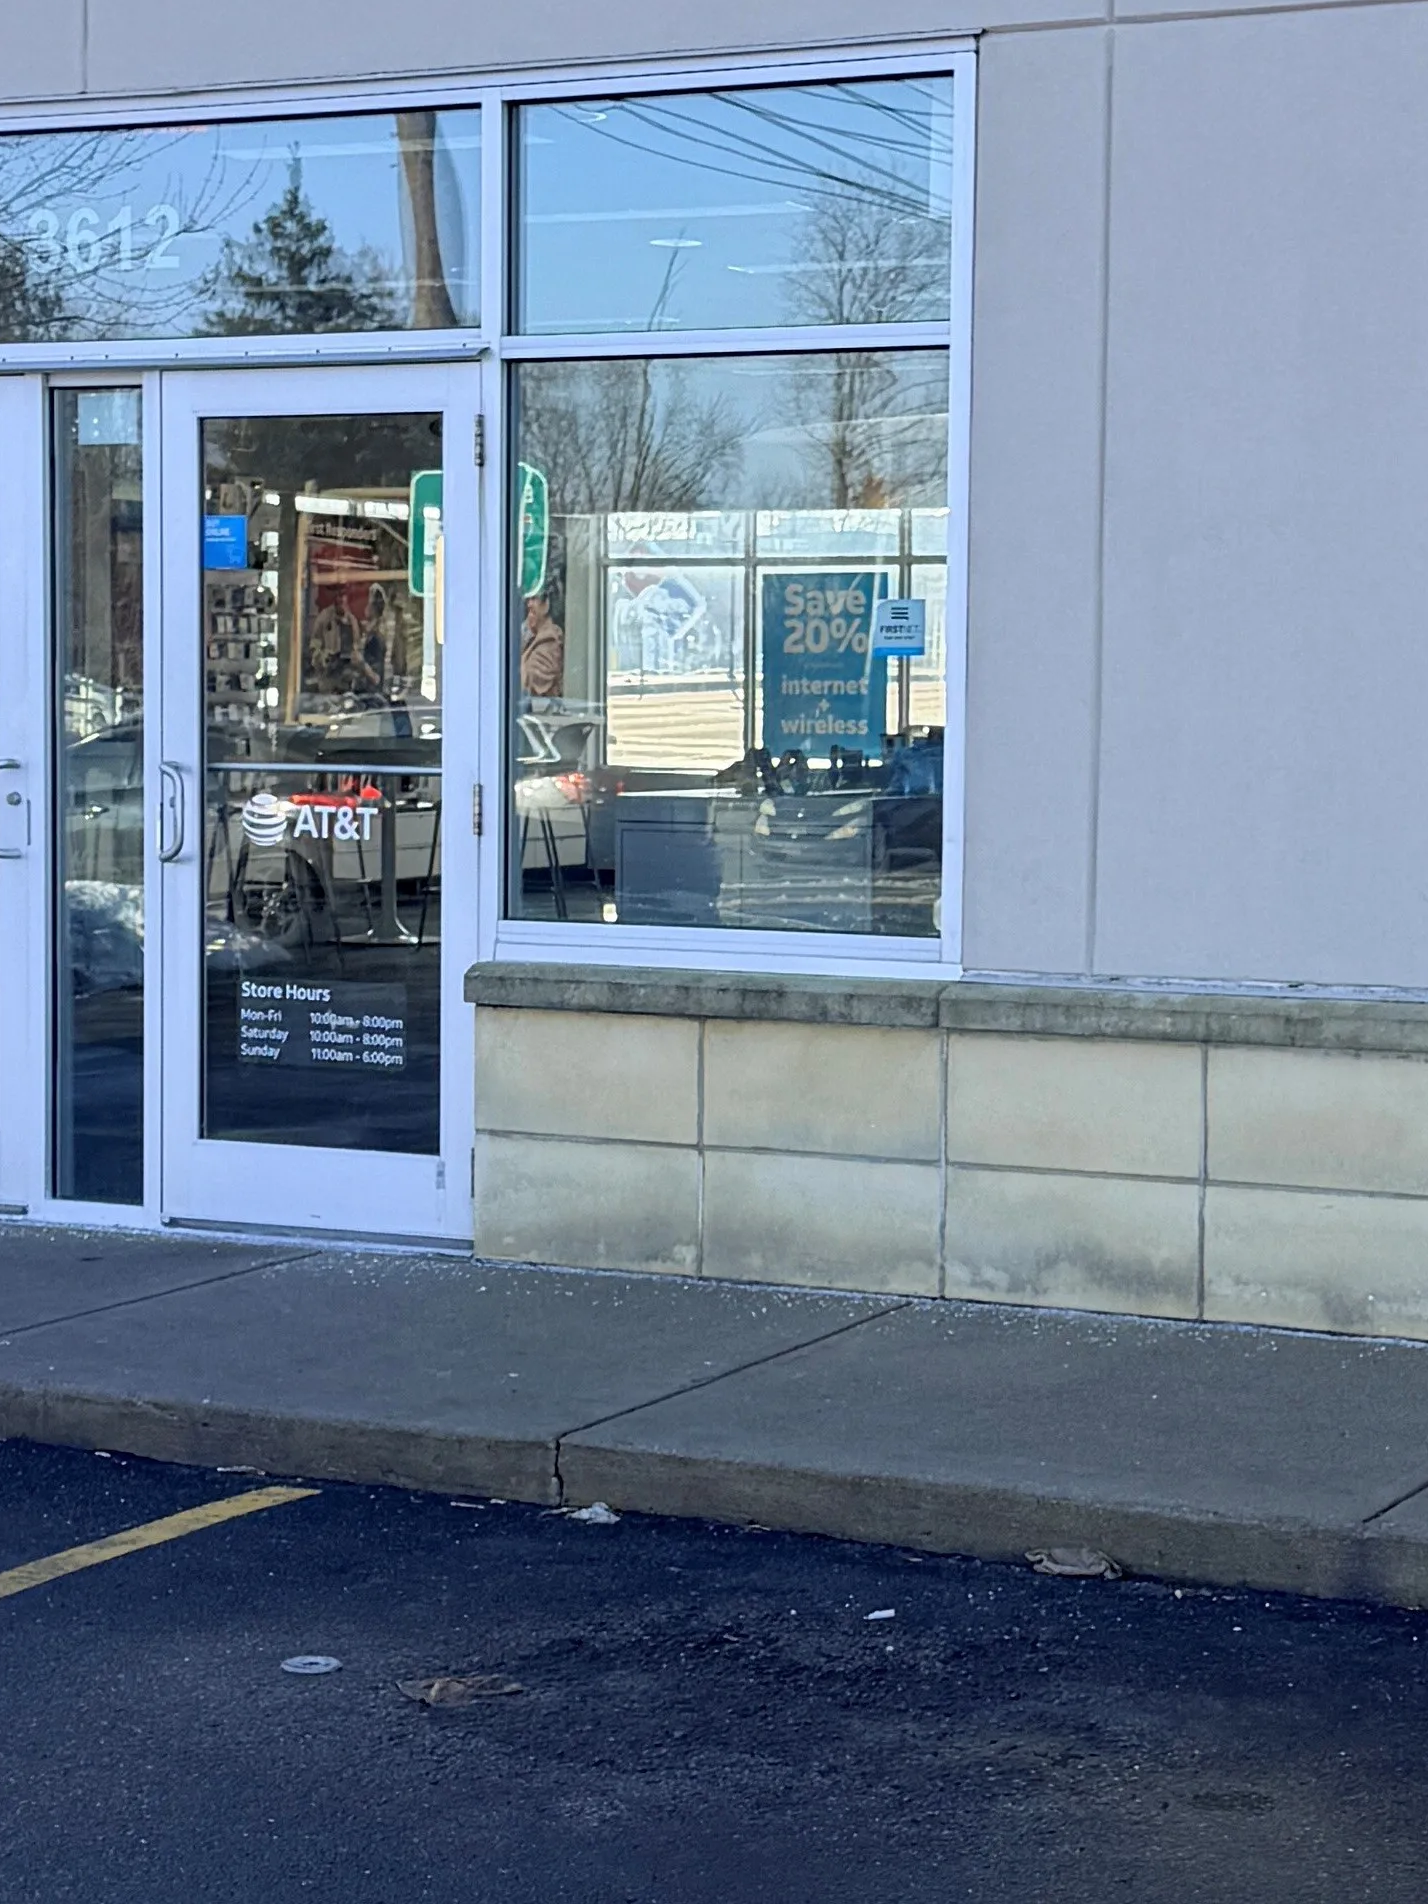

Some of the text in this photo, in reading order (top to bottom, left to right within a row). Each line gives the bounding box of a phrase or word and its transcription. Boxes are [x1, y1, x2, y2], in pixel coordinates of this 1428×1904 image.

[28, 204, 180, 273] 3612
[784, 583, 867, 615] Save
[783, 617, 869, 653] 20%
[781, 675, 870, 695] internet
[781, 713, 869, 735] wireless
[293, 804, 379, 840] AT&T
[241, 981, 331, 1002] Store Hours
[240, 1008, 282, 1022] Mon-Fri
[362, 1015, 403, 1030] 8:00pm
[240, 1025, 289, 1043] Saturday
[310, 1030, 353, 1044] 10:00am
[362, 1033, 403, 1048] 8:00pm
[240, 1043, 280, 1060] Sunday
[311, 1048, 353, 1062] 11:00am
[362, 1051, 403, 1066] 6:00pm
